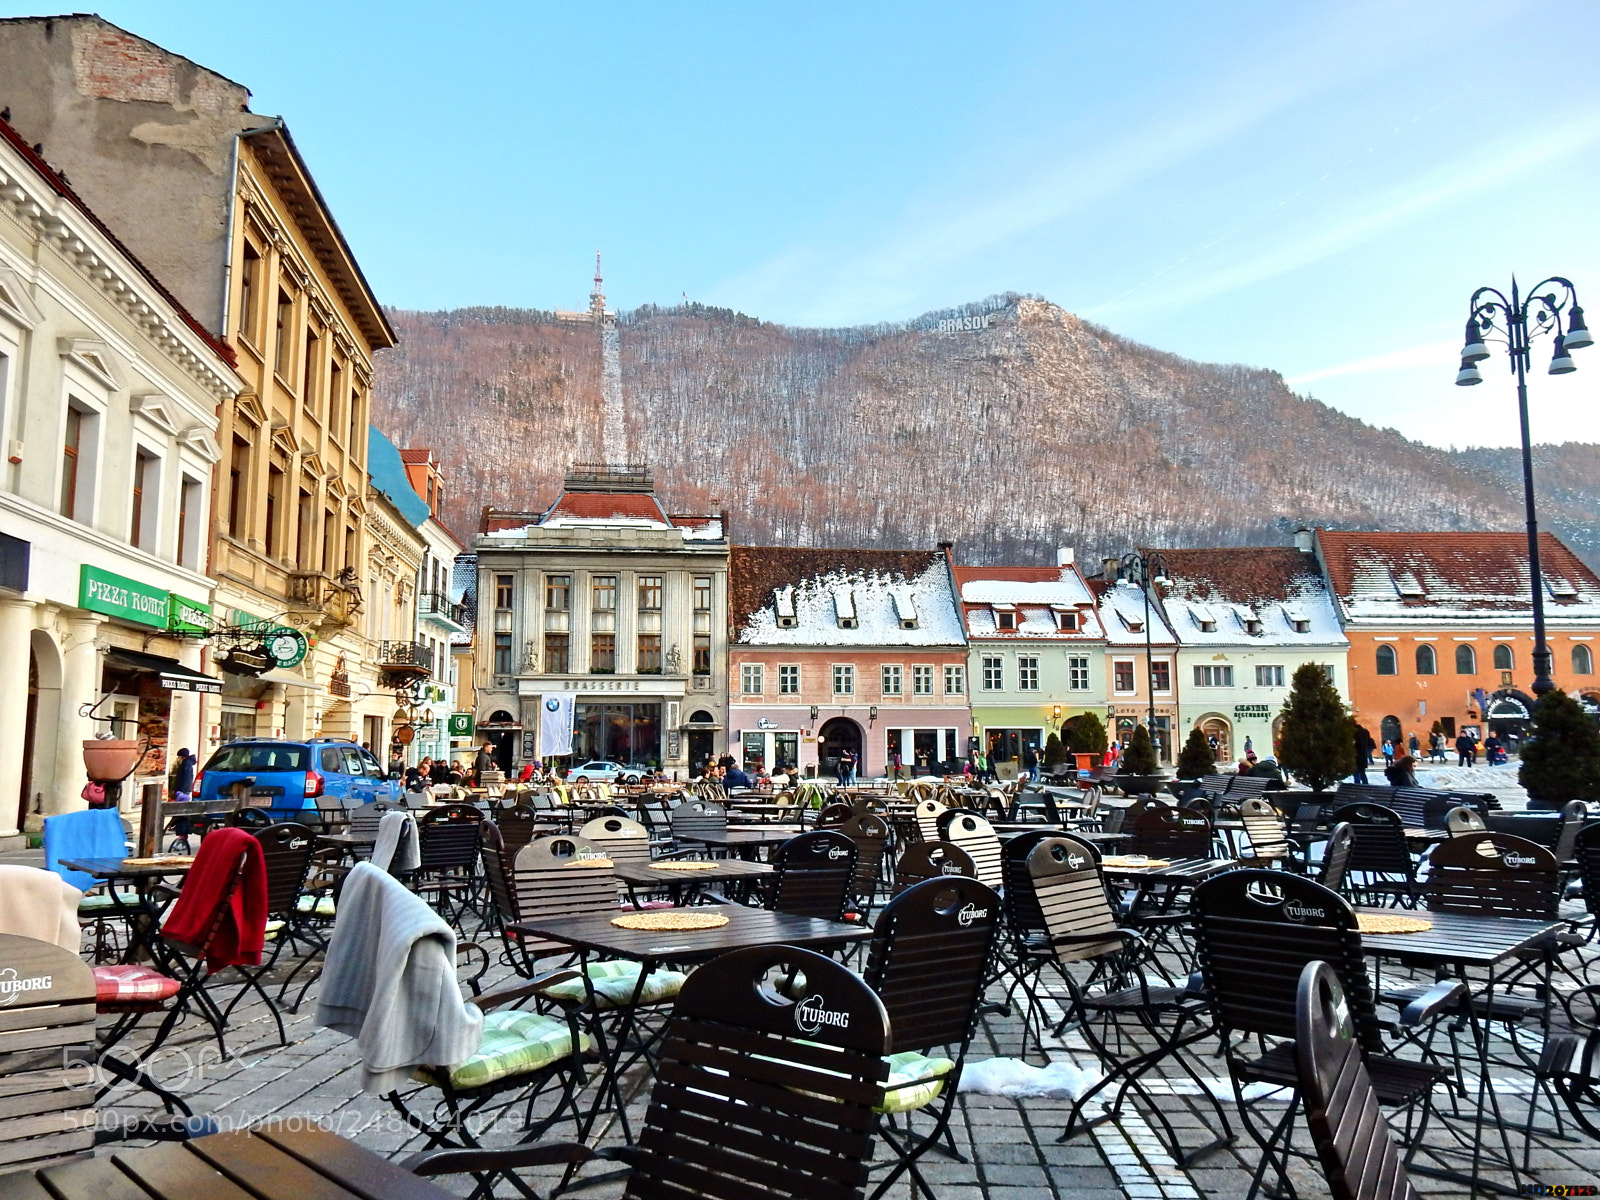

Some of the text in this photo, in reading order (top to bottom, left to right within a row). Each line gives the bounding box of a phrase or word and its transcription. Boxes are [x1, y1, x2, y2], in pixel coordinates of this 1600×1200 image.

[940, 315, 989, 332] BRASOV
[88, 579, 166, 617] PIZZA ROMA
[564, 681, 639, 691] BRASSERIE
[580, 852, 607, 860] TUBORG
[962, 909, 987, 920] TUBORG
[1288, 907, 1325, 917] TUBORG
[0, 976, 52, 993] UBORG
[803, 1006, 849, 1028] TUBORG
